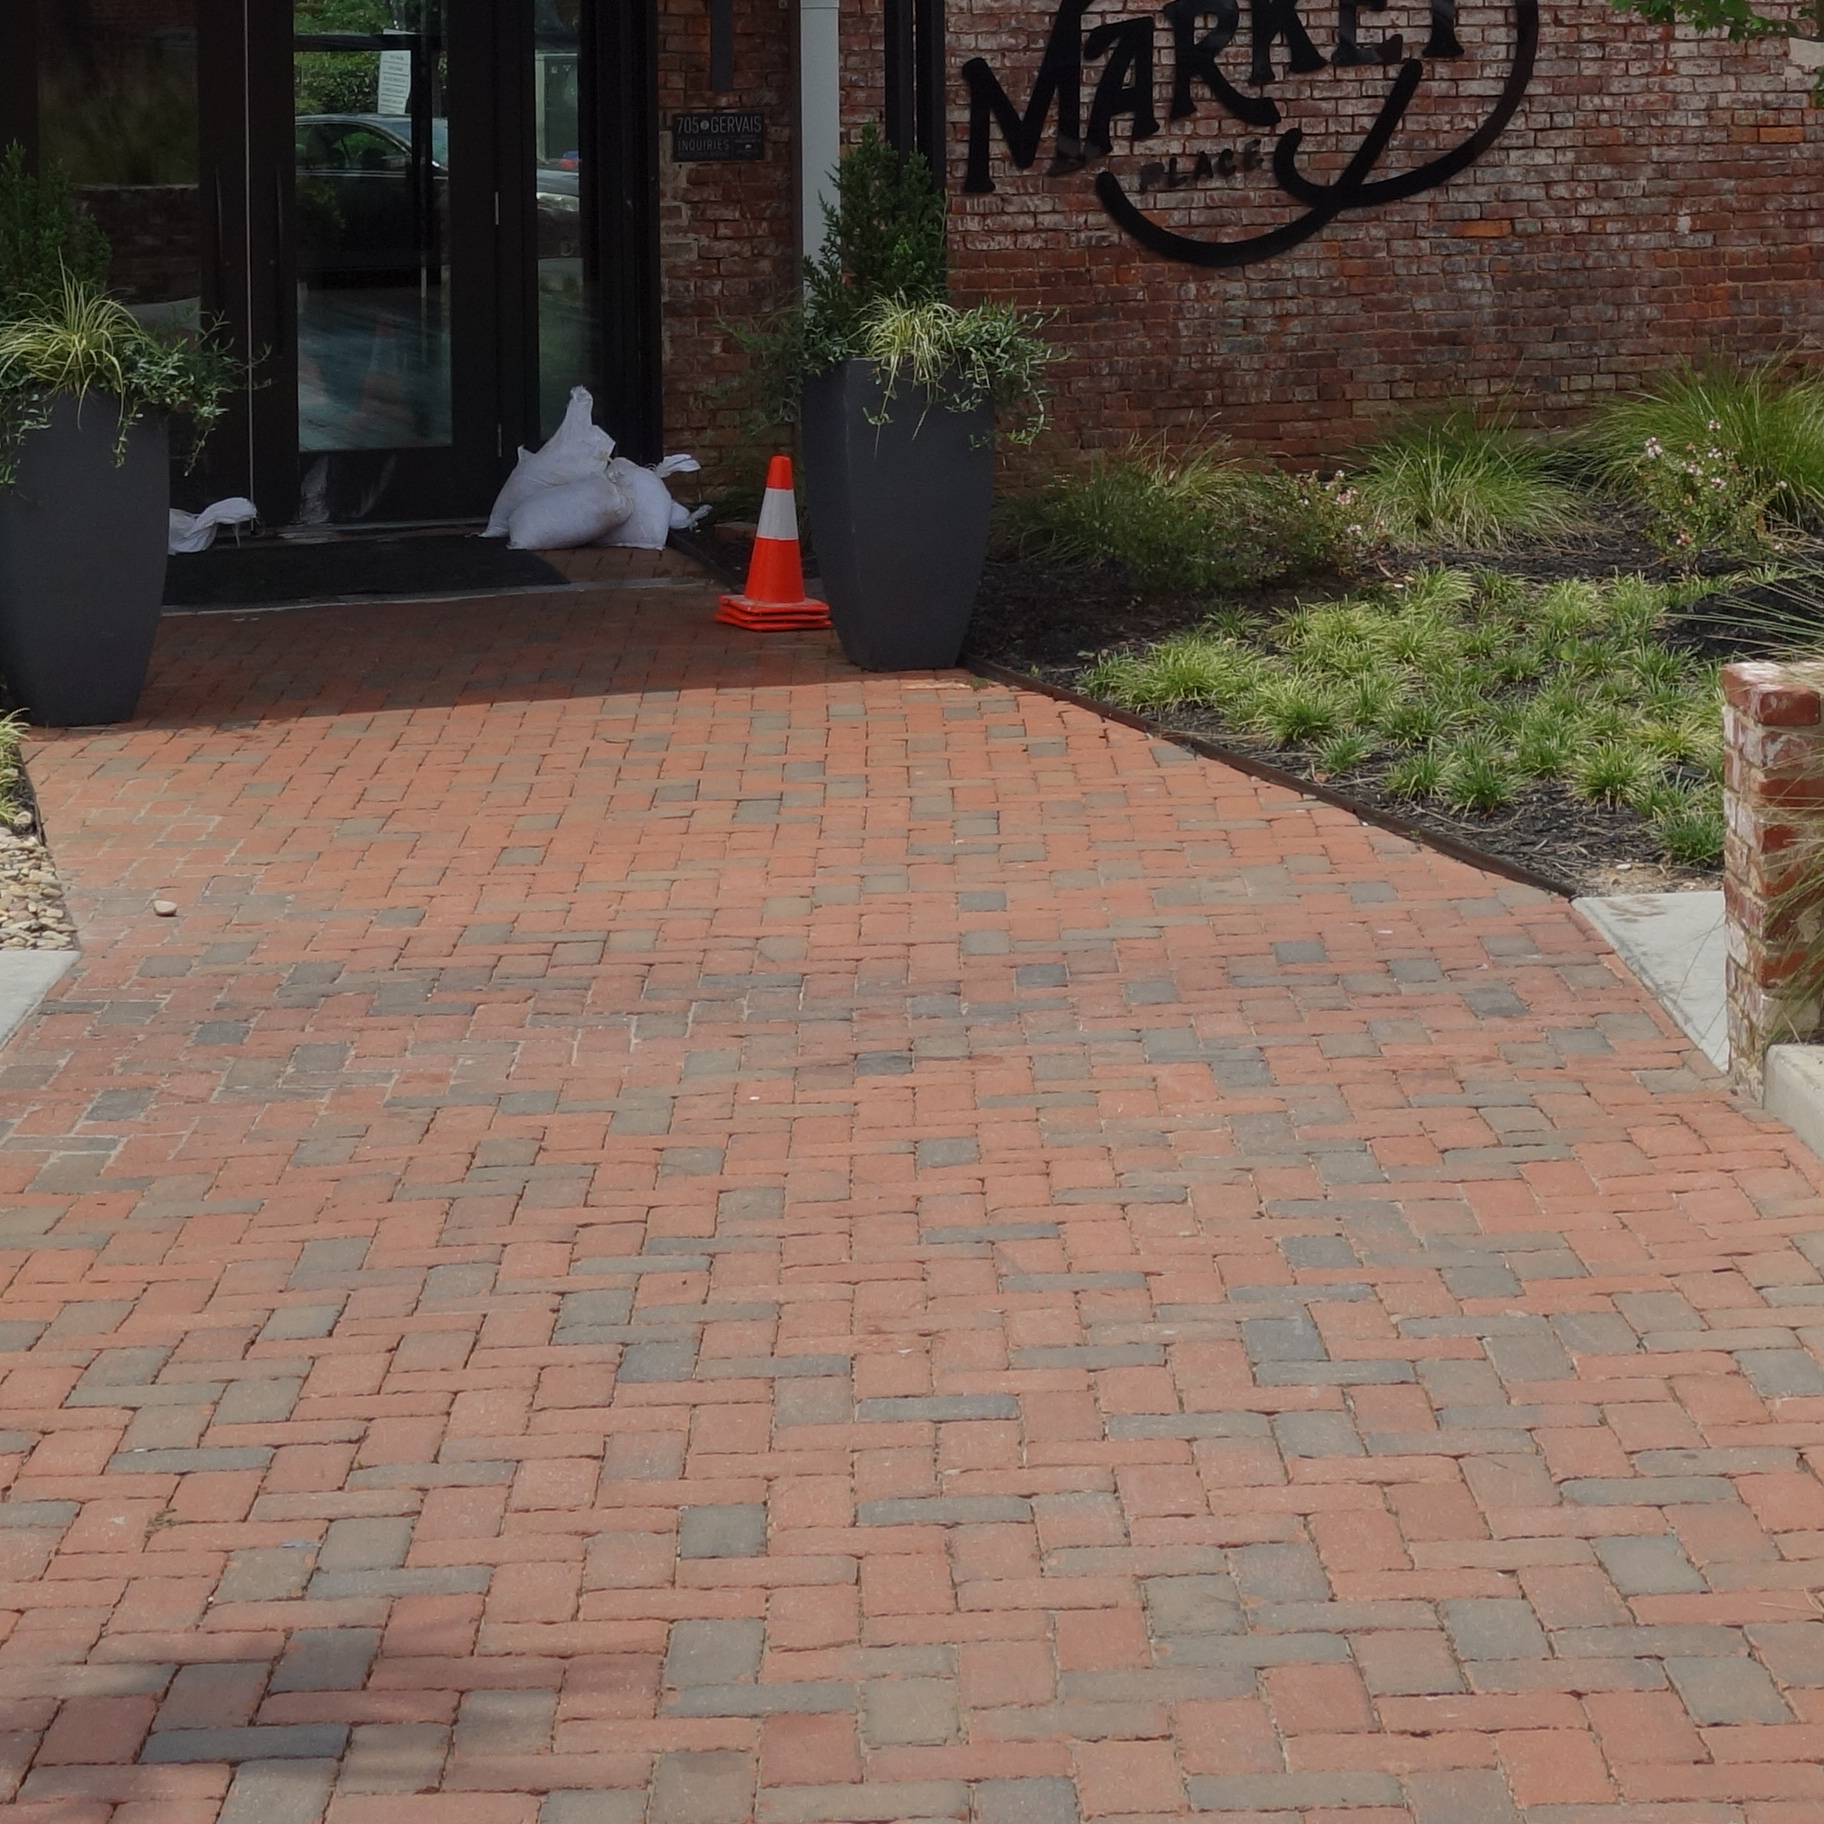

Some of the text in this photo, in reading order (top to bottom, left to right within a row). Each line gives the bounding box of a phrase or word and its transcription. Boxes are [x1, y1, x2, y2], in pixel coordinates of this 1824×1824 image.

[677, 116, 762, 134] 705 GERVAIS
[677, 138, 730, 152] INQUIRIES
[1139, 137, 1265, 195] PLACE
